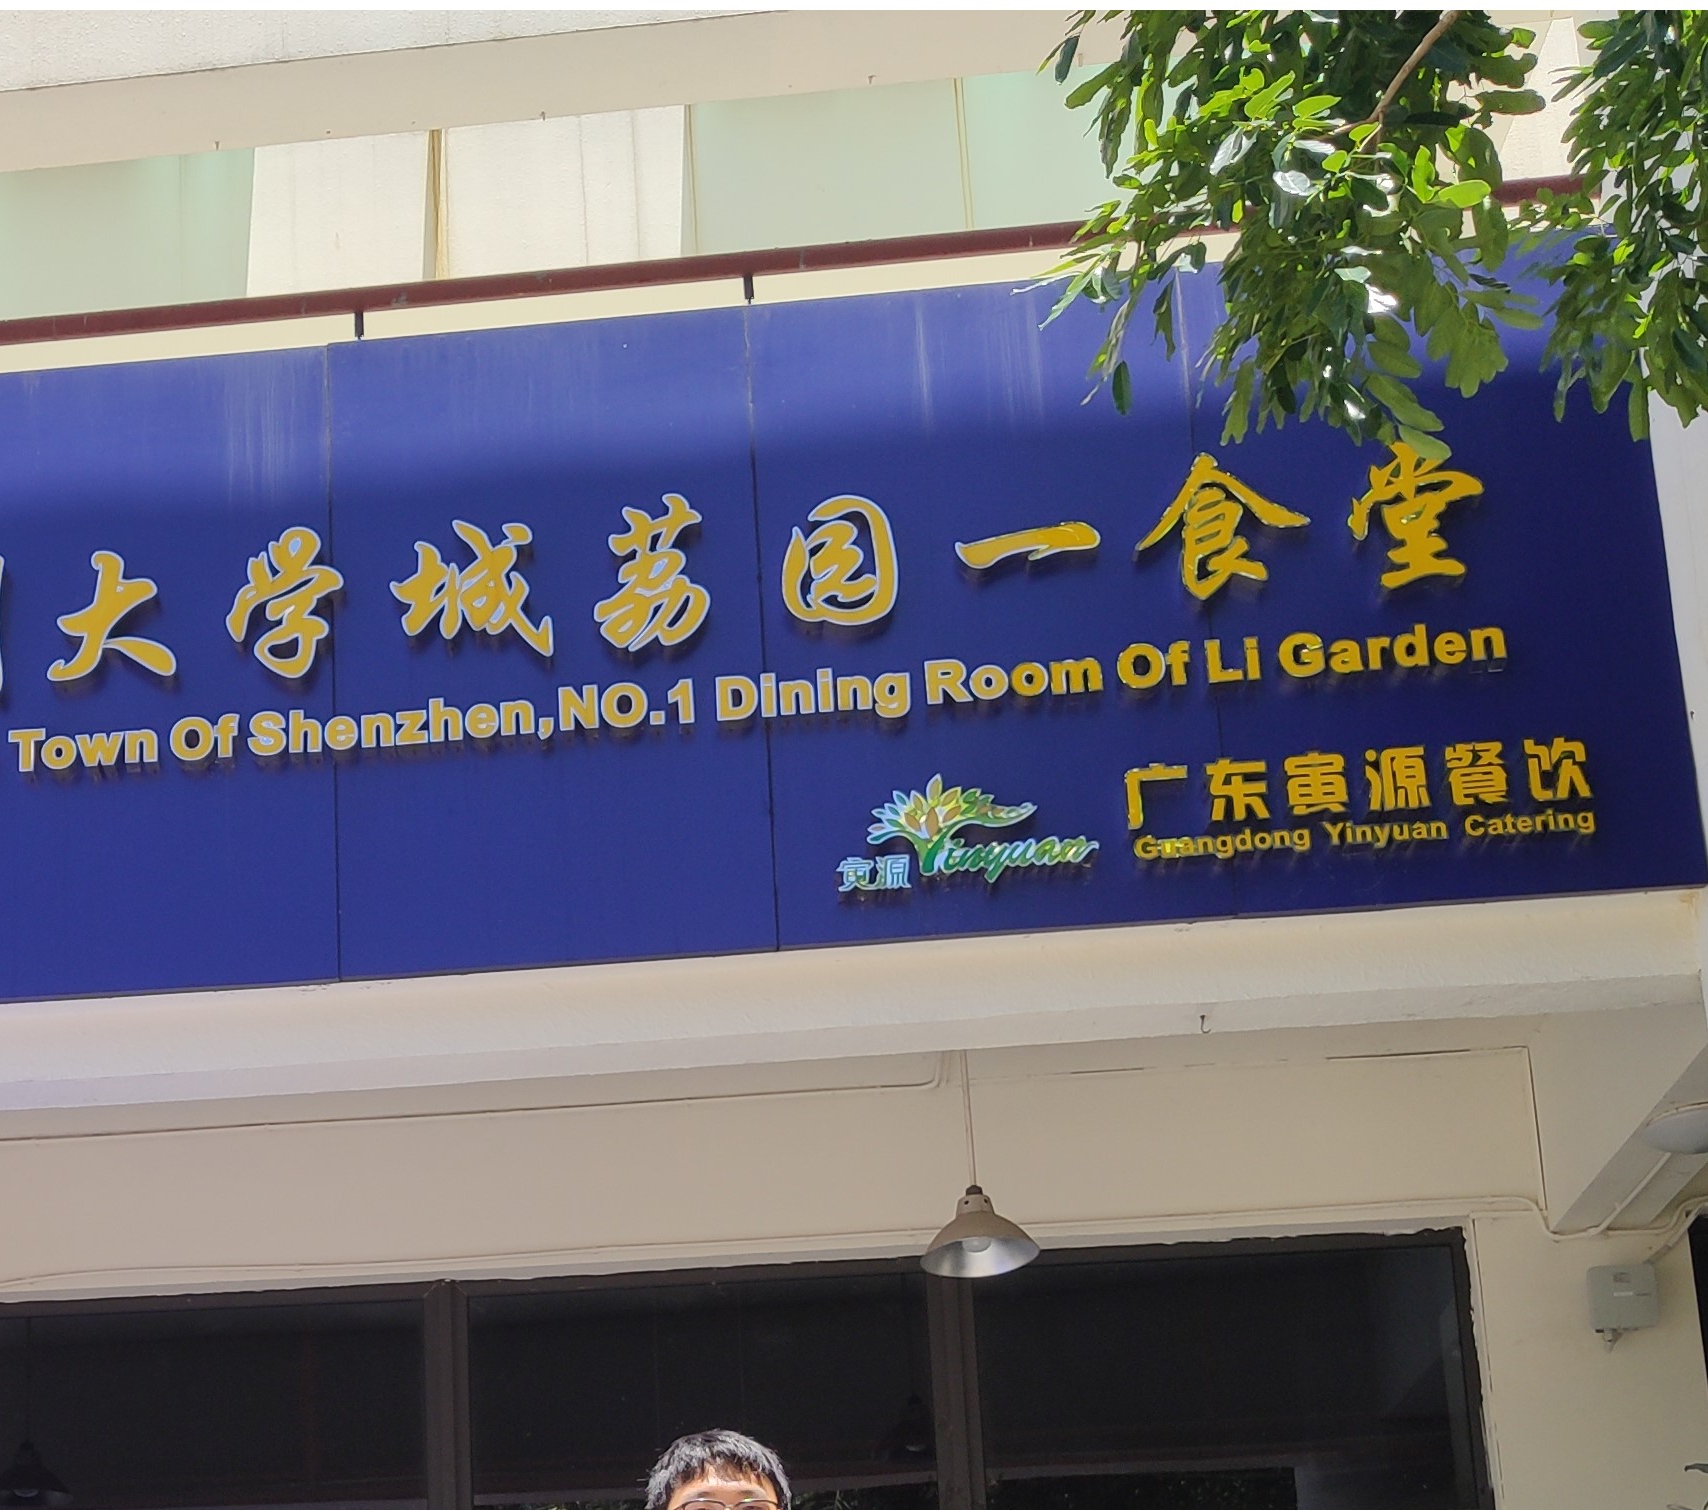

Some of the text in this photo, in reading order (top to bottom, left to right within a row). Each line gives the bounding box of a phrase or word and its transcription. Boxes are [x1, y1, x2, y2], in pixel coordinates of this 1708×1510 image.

[9, 720, 158, 775] Town
[168, 711, 239, 762] Of
[716, 668, 910, 727] Dining
[923, 651, 1102, 704] Room
[1117, 640, 1190, 690] Of
[1204, 634, 1260, 684] Li
[1278, 622, 1506, 678] Garden
[1124, 737, 1592, 830] 广东寅源餐饮
[1134, 806, 1596, 861] Guangdong Yinyuan Catering
